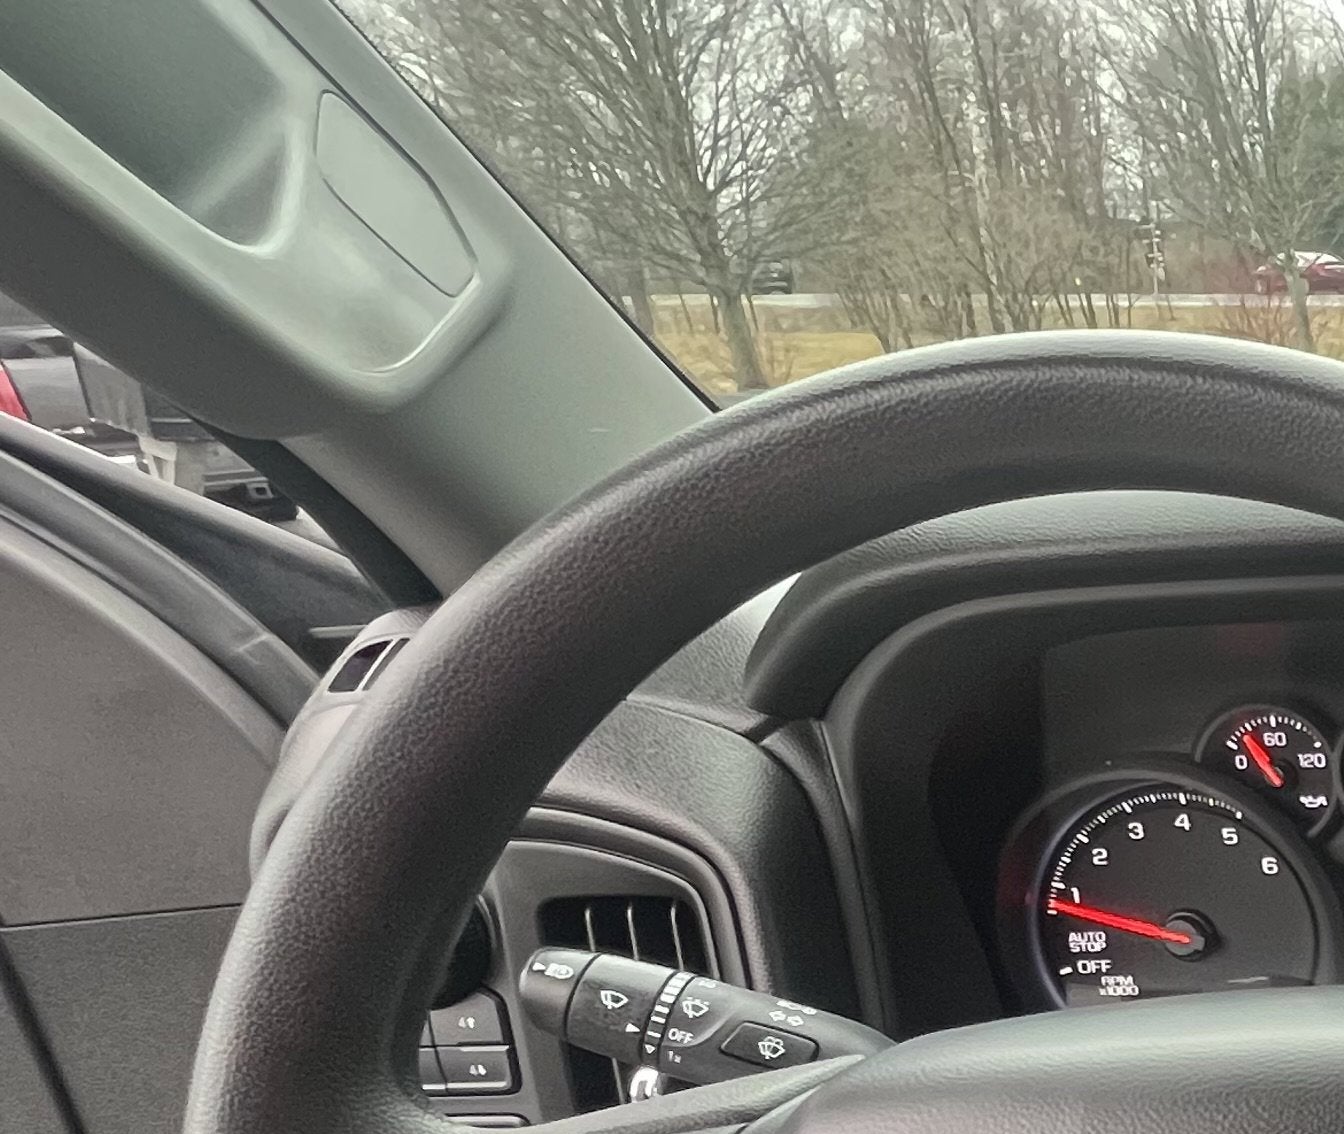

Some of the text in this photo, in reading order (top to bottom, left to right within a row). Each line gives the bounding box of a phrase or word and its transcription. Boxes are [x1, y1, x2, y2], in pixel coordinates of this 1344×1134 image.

[1263, 732, 1287, 747] 60
[1234, 754, 1248, 770] 0
[1298, 753, 1326, 769] 120
[1173, 813, 1192, 832] 4
[1127, 822, 1145, 840] 3
[1220, 827, 1239, 845] 5
[1091, 848, 1108, 866] 2
[1260, 857, 1279, 875] 6
[1070, 887, 1080, 904] 1
[1068, 931, 1107, 942] AUTO
[1068, 942, 1107, 953] STOP
[1076, 960, 1112, 974] OFF
[1100, 975, 1134, 986] RPM
[668, 1028, 694, 1044] OFF
